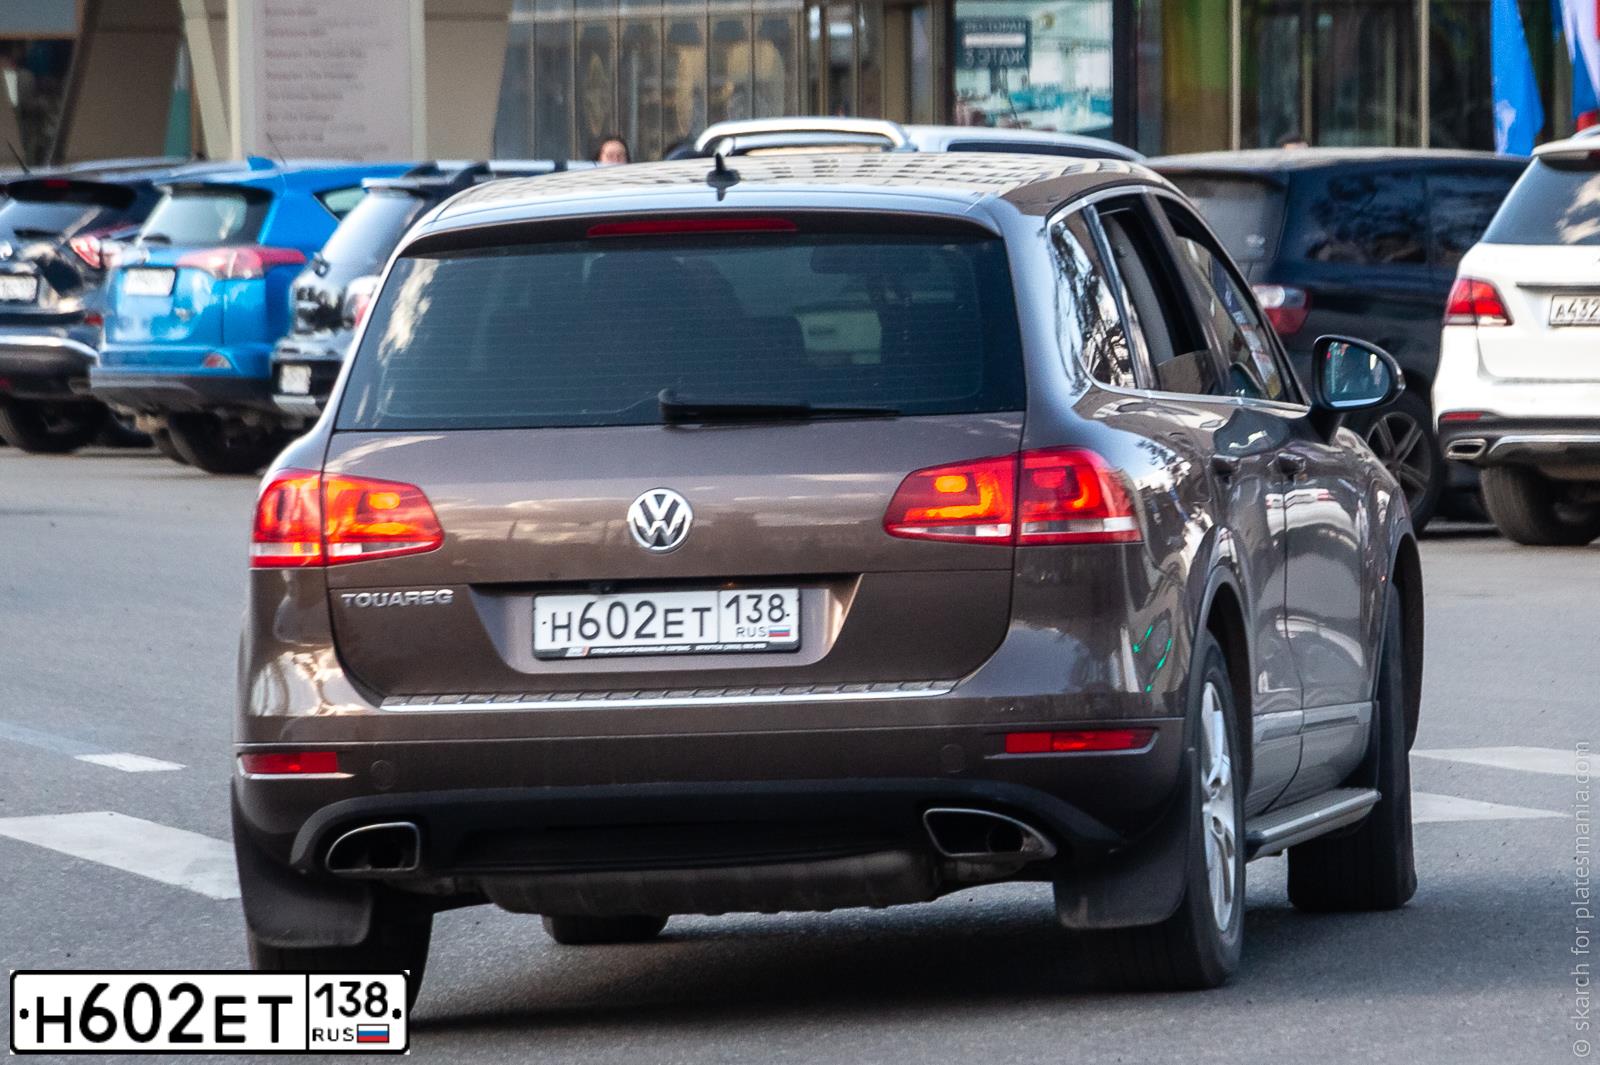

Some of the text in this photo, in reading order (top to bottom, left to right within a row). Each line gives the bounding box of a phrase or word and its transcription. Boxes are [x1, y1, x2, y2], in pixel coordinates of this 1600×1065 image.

[340, 589, 454, 607] TOUAREG
[725, 593, 785, 624] 138
[736, 626, 767, 638] RUS
